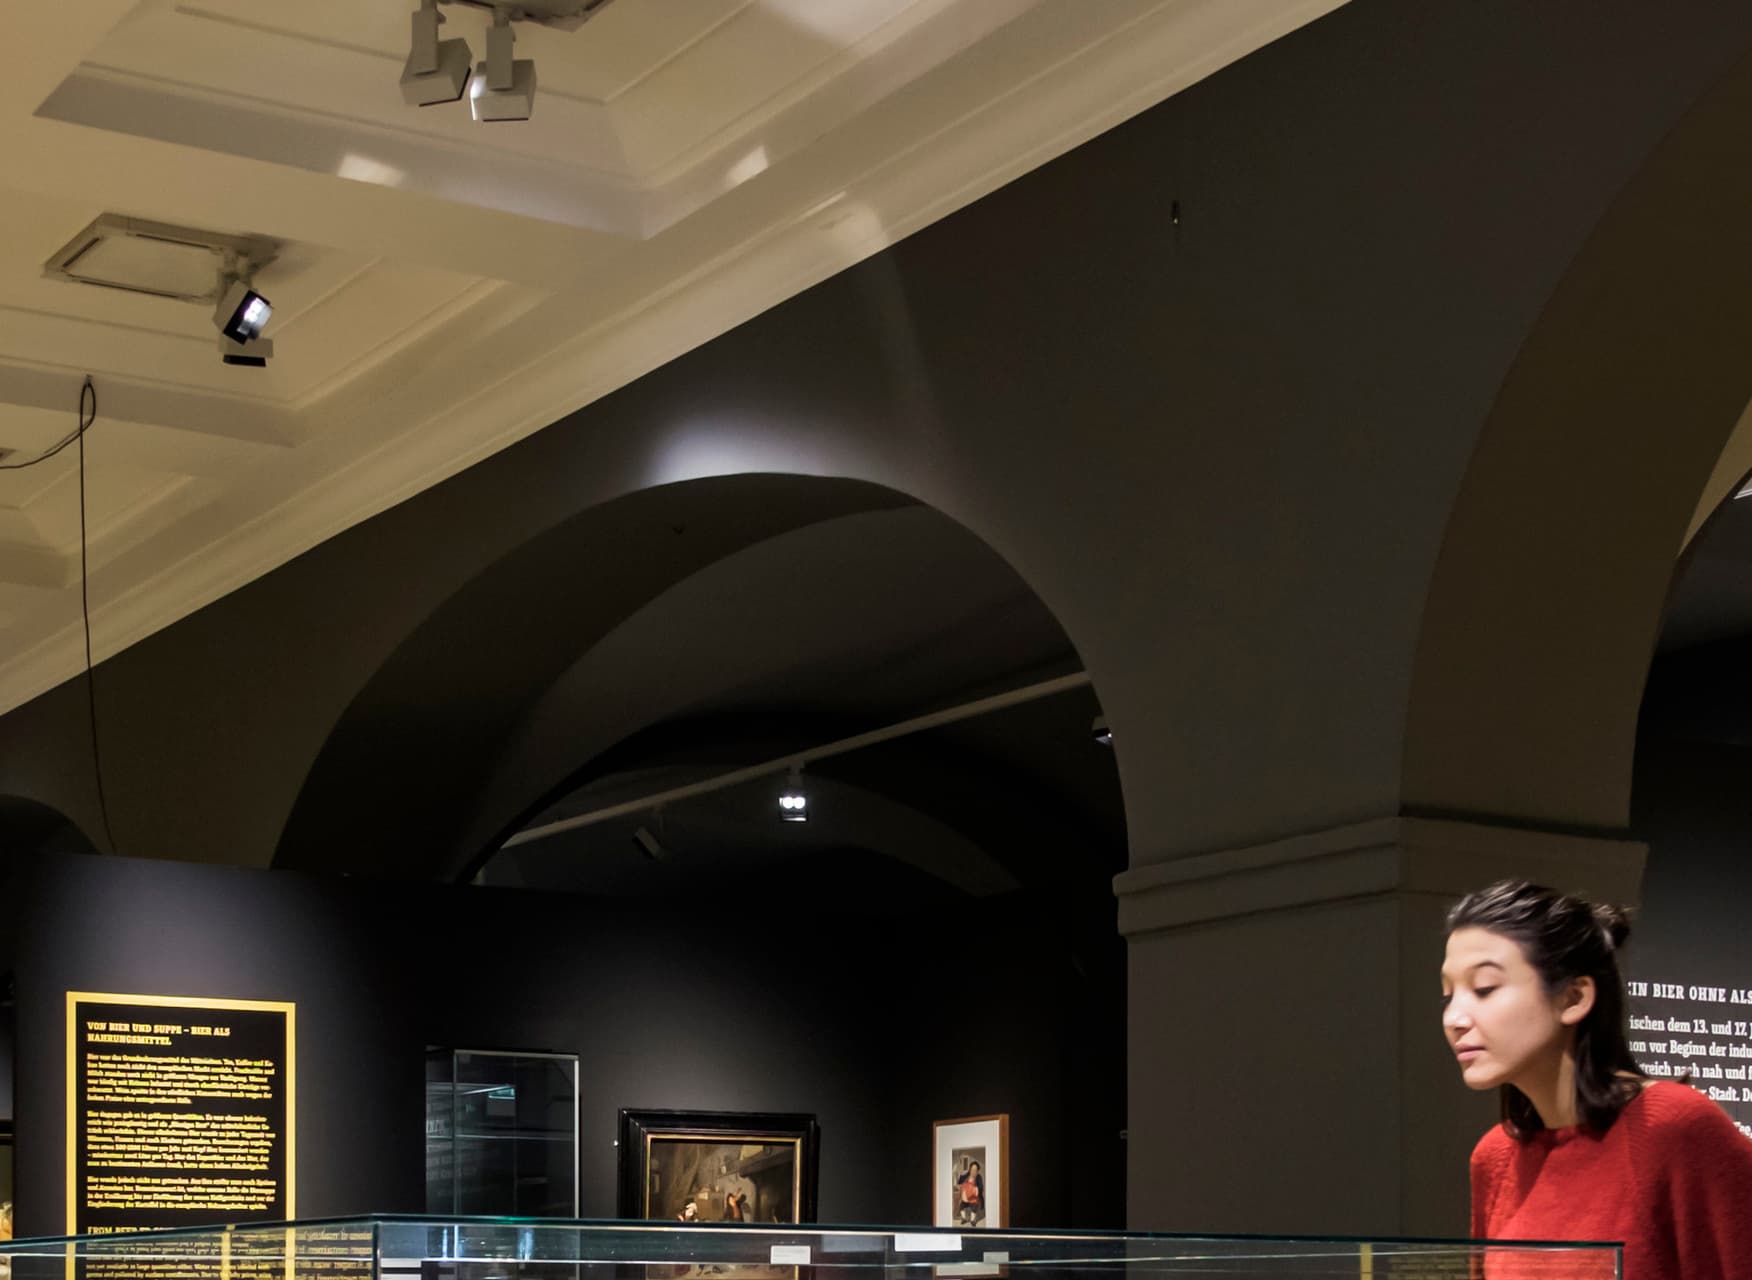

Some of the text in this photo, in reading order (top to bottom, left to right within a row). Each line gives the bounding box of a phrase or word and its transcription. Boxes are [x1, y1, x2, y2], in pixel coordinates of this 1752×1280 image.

[1628, 982, 1648, 996] IN
[1653, 983, 1685, 999] BIER
[1689, 986, 1726, 1002] OHNE
[86, 1021, 107, 1031] VON
[109, 1022, 130, 1032] BIER
[132, 1023, 152, 1033] UND
[153, 1024, 182, 1034] SUPPE
[191, 1026, 212, 1036] BIER
[213, 1027, 230, 1036] ALS
[1668, 1017, 1690, 1032] dem
[1693, 1019, 1709, 1034] 13.
[1711, 1020, 1732, 1035] und
[1734, 1022, 1748, 1036] 17.
[1649, 1042, 1667, 1053] vor
[1670, 1040, 1707, 1058] Beginn
[1709, 1041, 1727, 1057] der
[1702, 1063, 1723, 1079] nah
[1725, 1065, 1746, 1080] und
[1708, 1086, 1740, 1102] Stadt.
